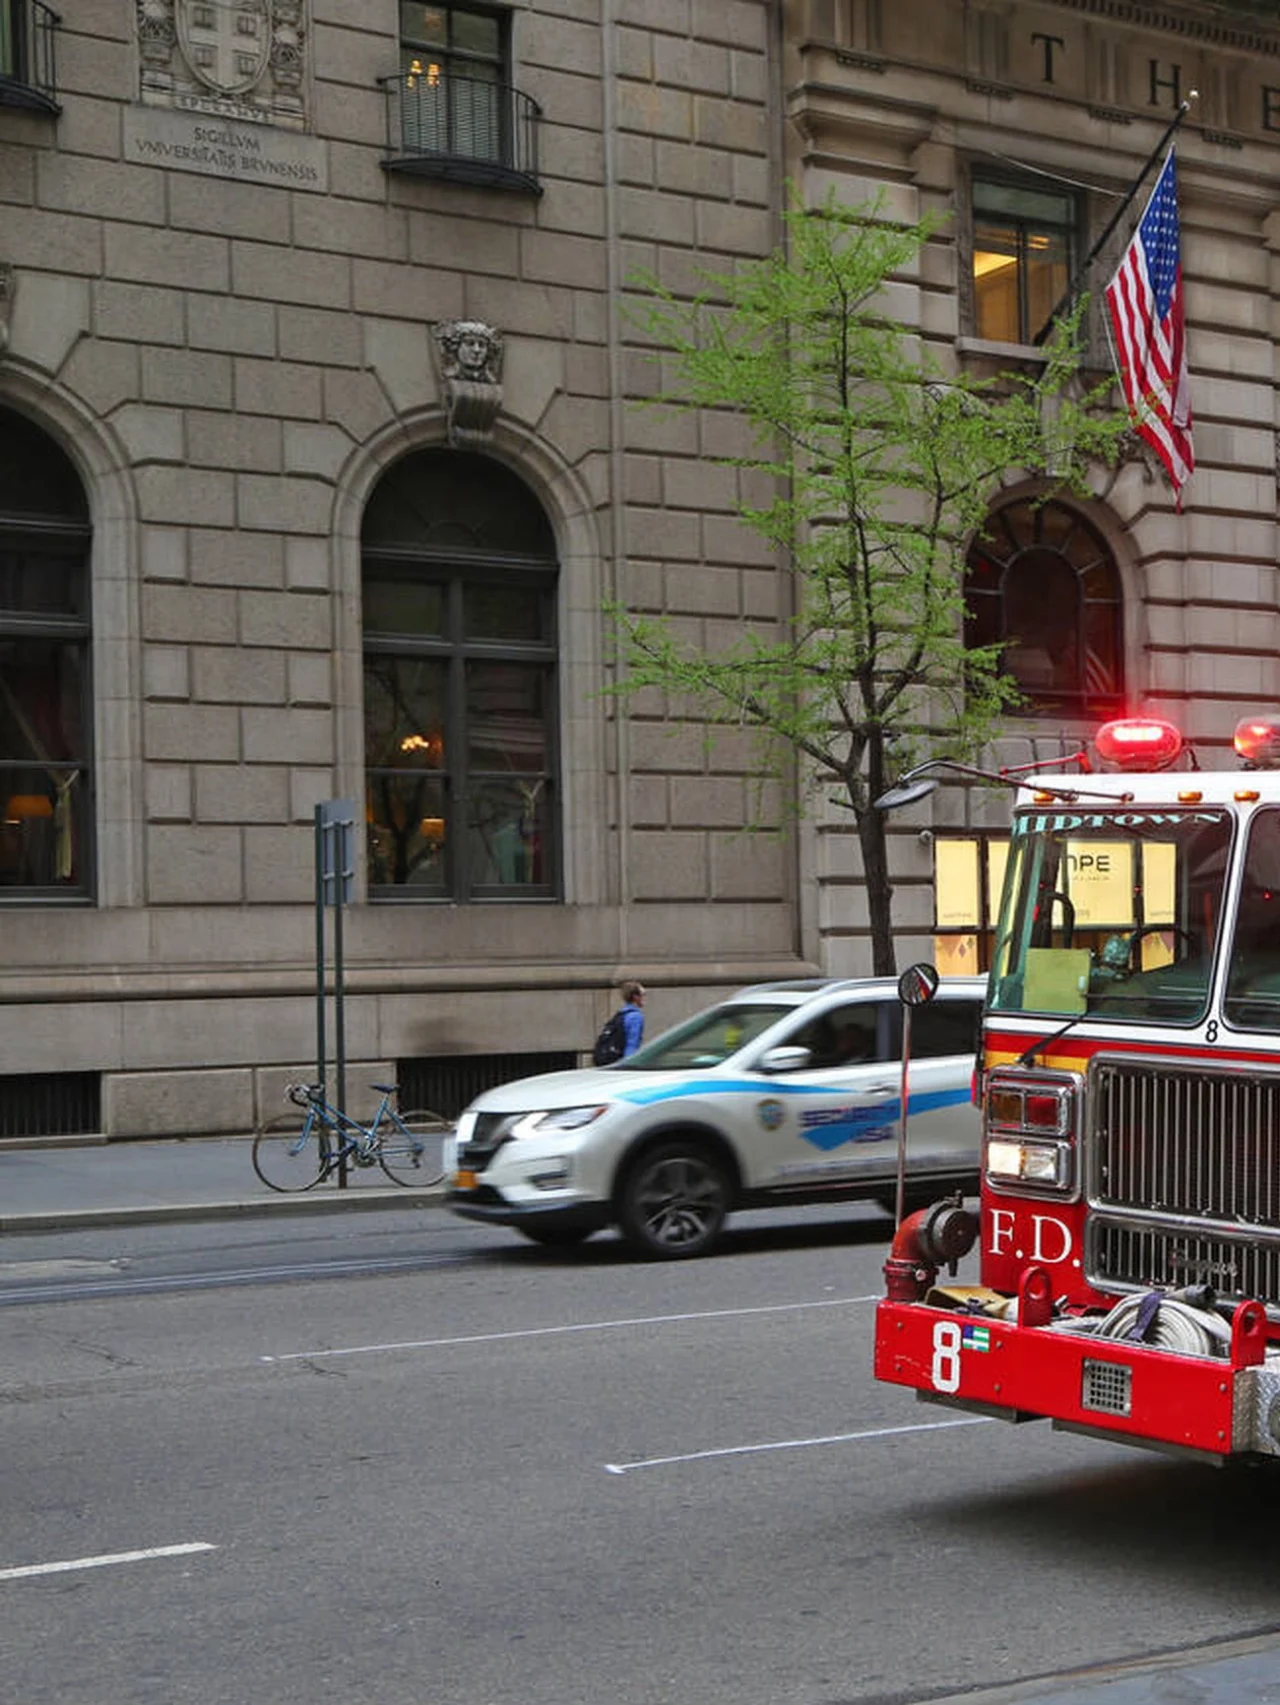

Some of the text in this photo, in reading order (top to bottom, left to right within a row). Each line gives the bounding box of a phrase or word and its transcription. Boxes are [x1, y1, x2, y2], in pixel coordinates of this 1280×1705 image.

[1205, 1019, 1219, 1043] 8
[987, 1208, 1081, 1268] F.D.
[932, 1320, 961, 1394] 8
